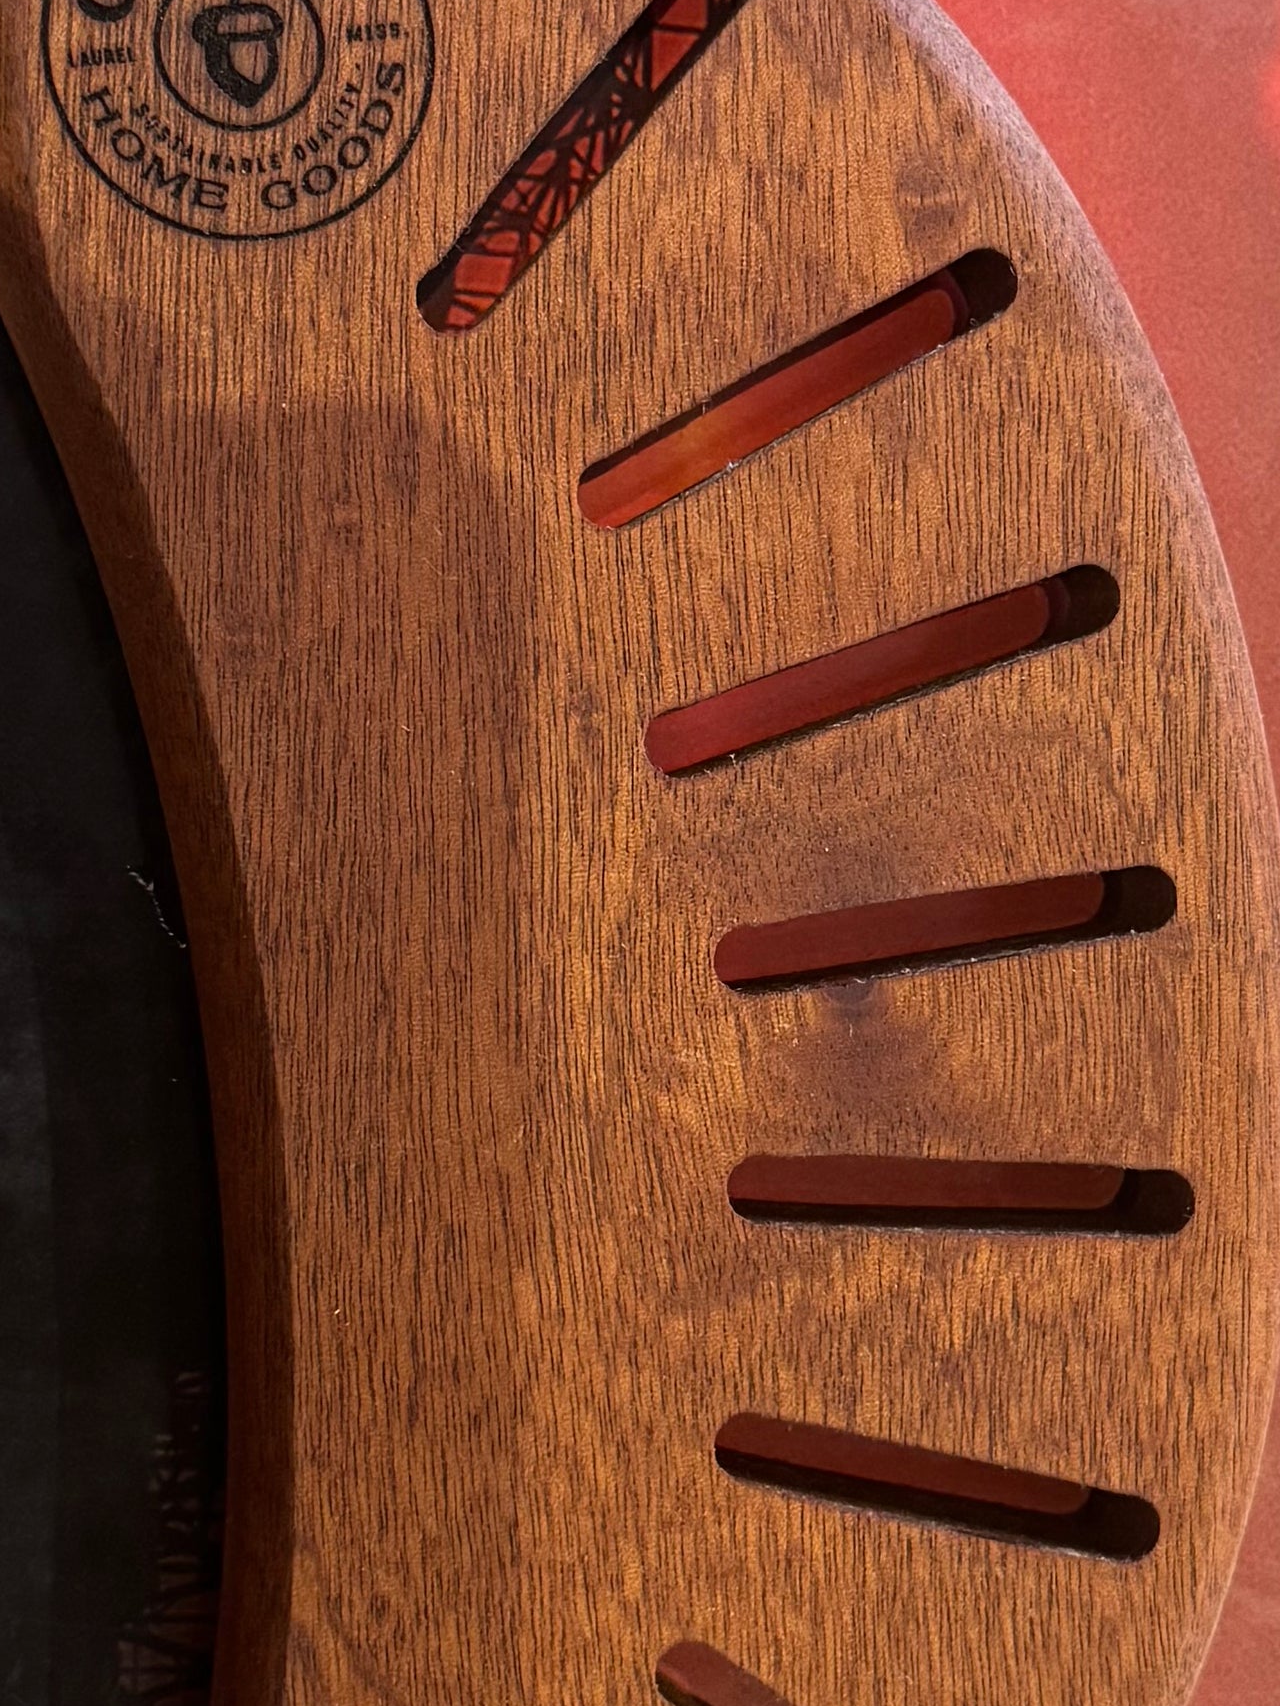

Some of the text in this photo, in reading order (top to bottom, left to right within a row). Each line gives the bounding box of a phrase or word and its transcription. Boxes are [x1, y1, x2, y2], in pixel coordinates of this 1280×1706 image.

[66, 47, 136, 68] LAUREL
[82, 62, 407, 212] HOME GOODS
[134, 82, 362, 175] SUSTAINABLE QUALITY
